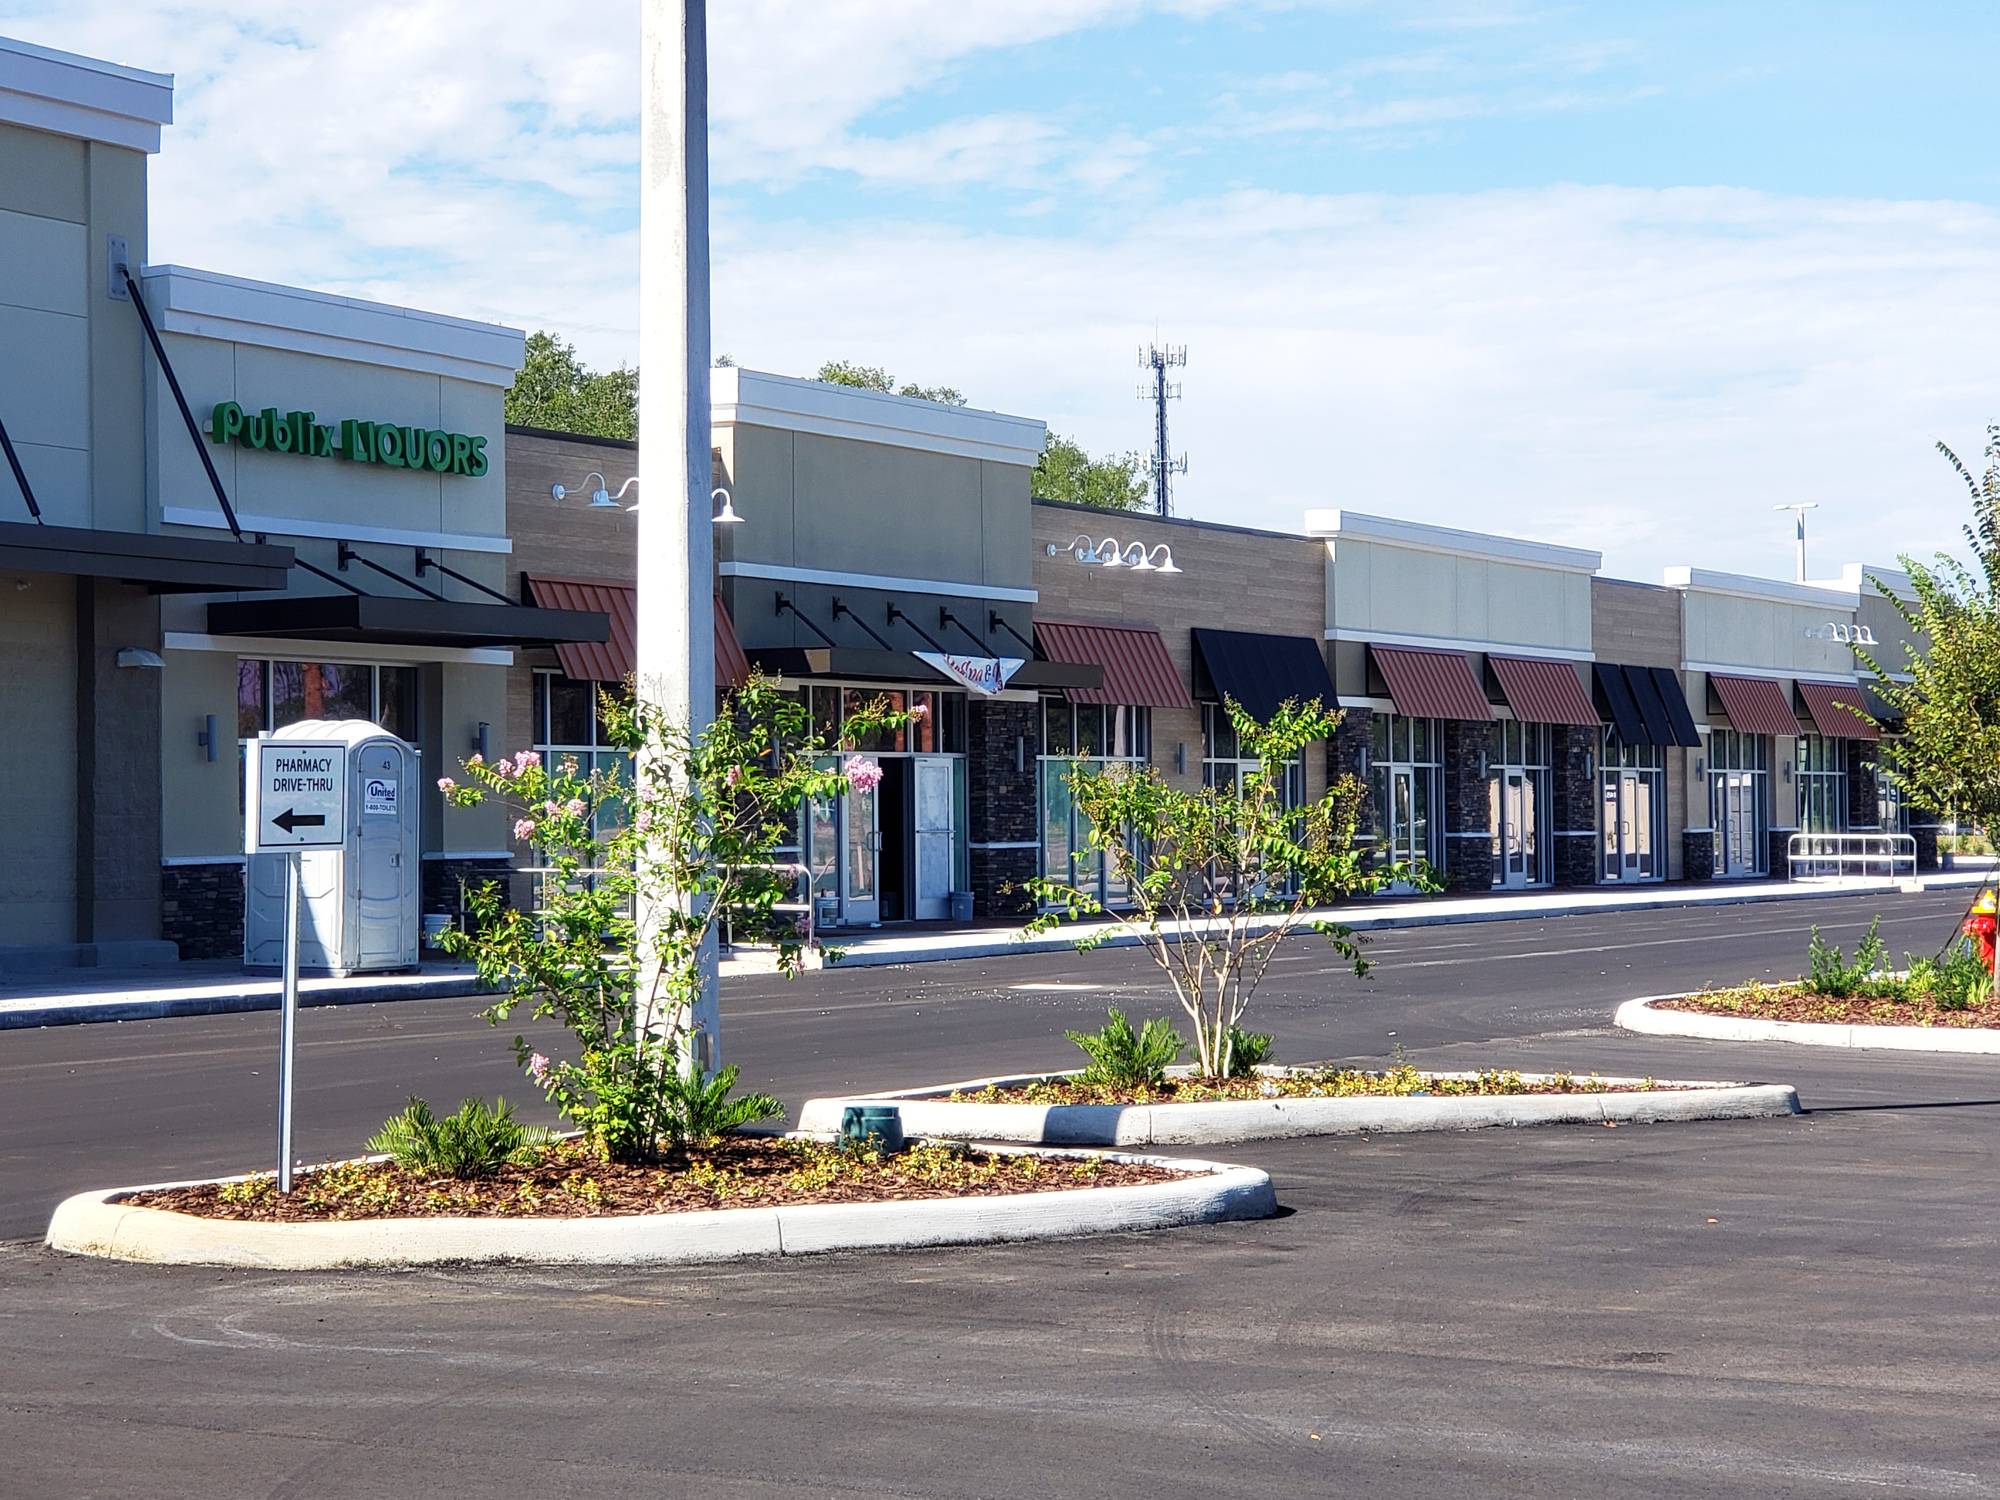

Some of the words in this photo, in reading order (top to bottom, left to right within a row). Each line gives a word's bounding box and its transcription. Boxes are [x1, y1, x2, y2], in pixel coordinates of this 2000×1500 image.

[213, 401, 335, 457] Publix
[341, 418, 489, 477] LIQUORS
[276, 758, 332, 772] PHARMACY
[382, 760, 391, 770] 43
[273, 778, 333, 792] DRIVE-THRU
[370, 785, 396, 798] United
